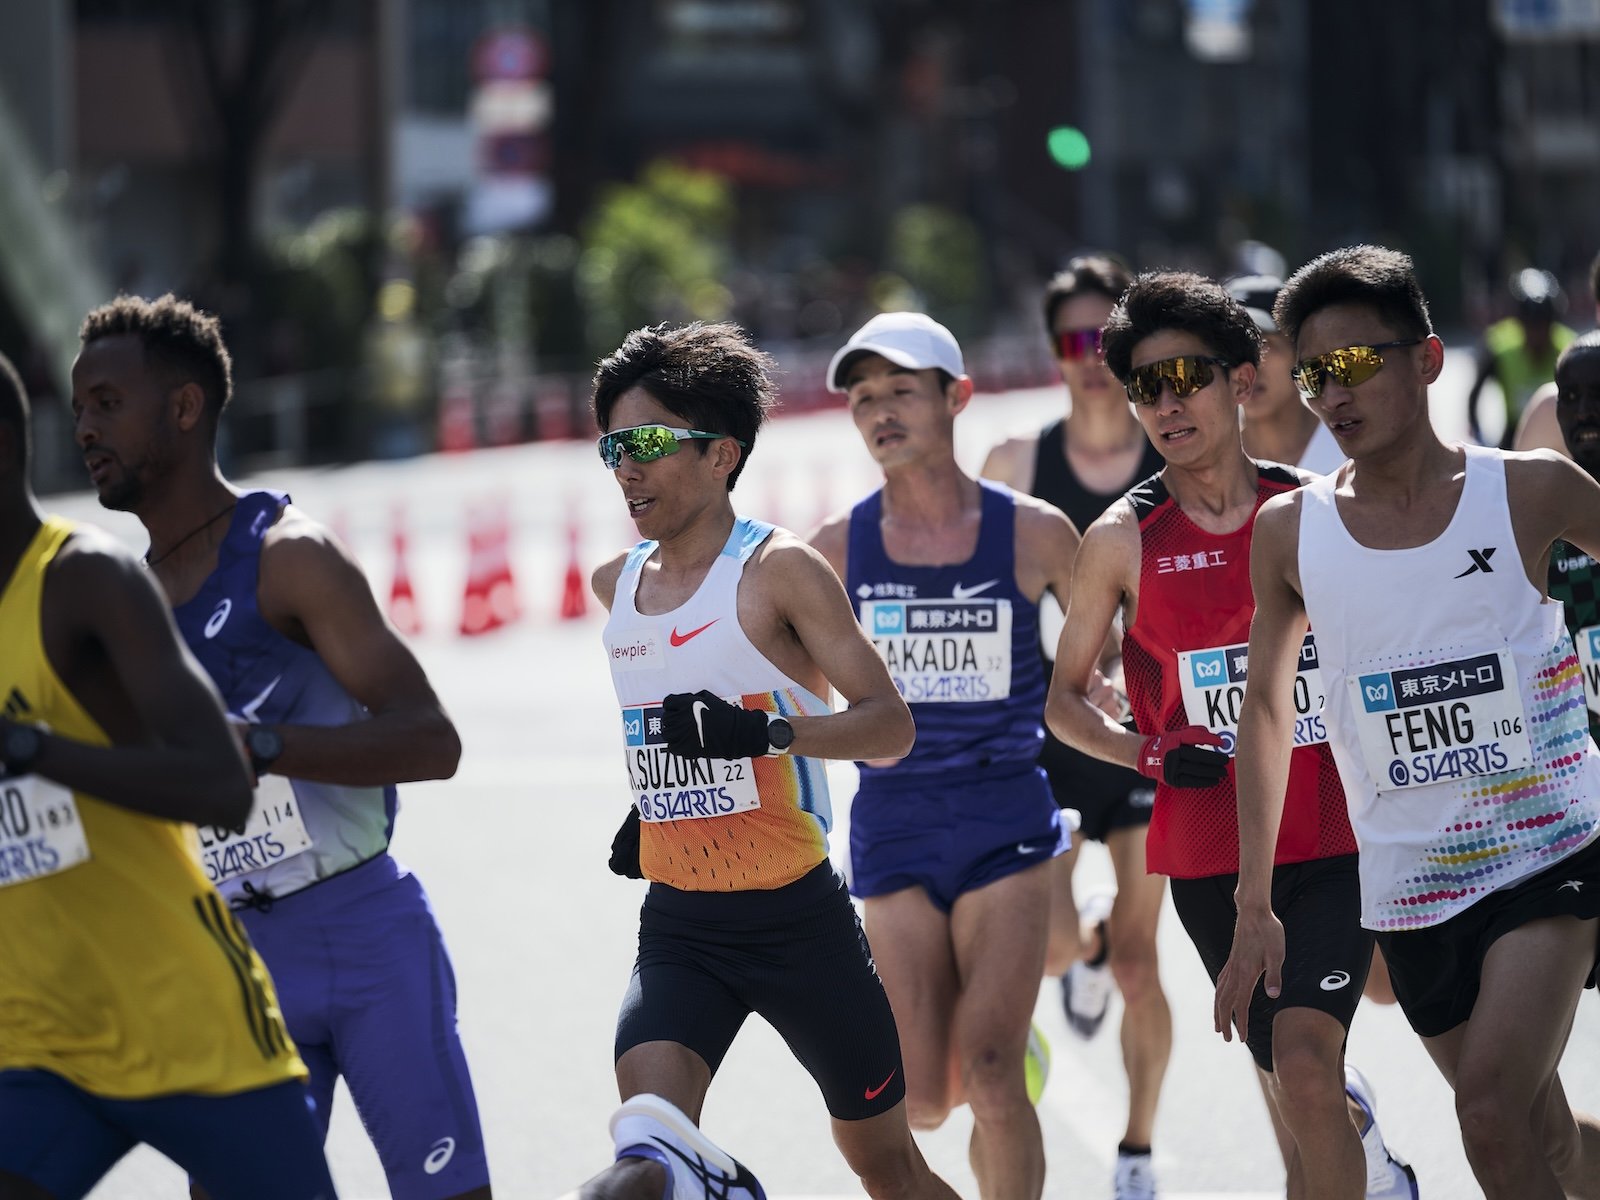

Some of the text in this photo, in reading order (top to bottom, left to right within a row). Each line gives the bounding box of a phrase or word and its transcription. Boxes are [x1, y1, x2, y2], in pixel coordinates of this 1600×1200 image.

[1157, 549, 1228, 574] 三菱重工
[910, 608, 994, 629] 東京メトロ
[910, 674, 990, 698] STARTS
[1400, 665, 1495, 698] 東京メトロ
[1385, 702, 1523, 756] FENG 106
[723, 764, 744, 782] 22
[1412, 742, 1508, 784] STARTS
[263, 801, 293, 827] 114
[653, 786, 735, 820] STARTS
